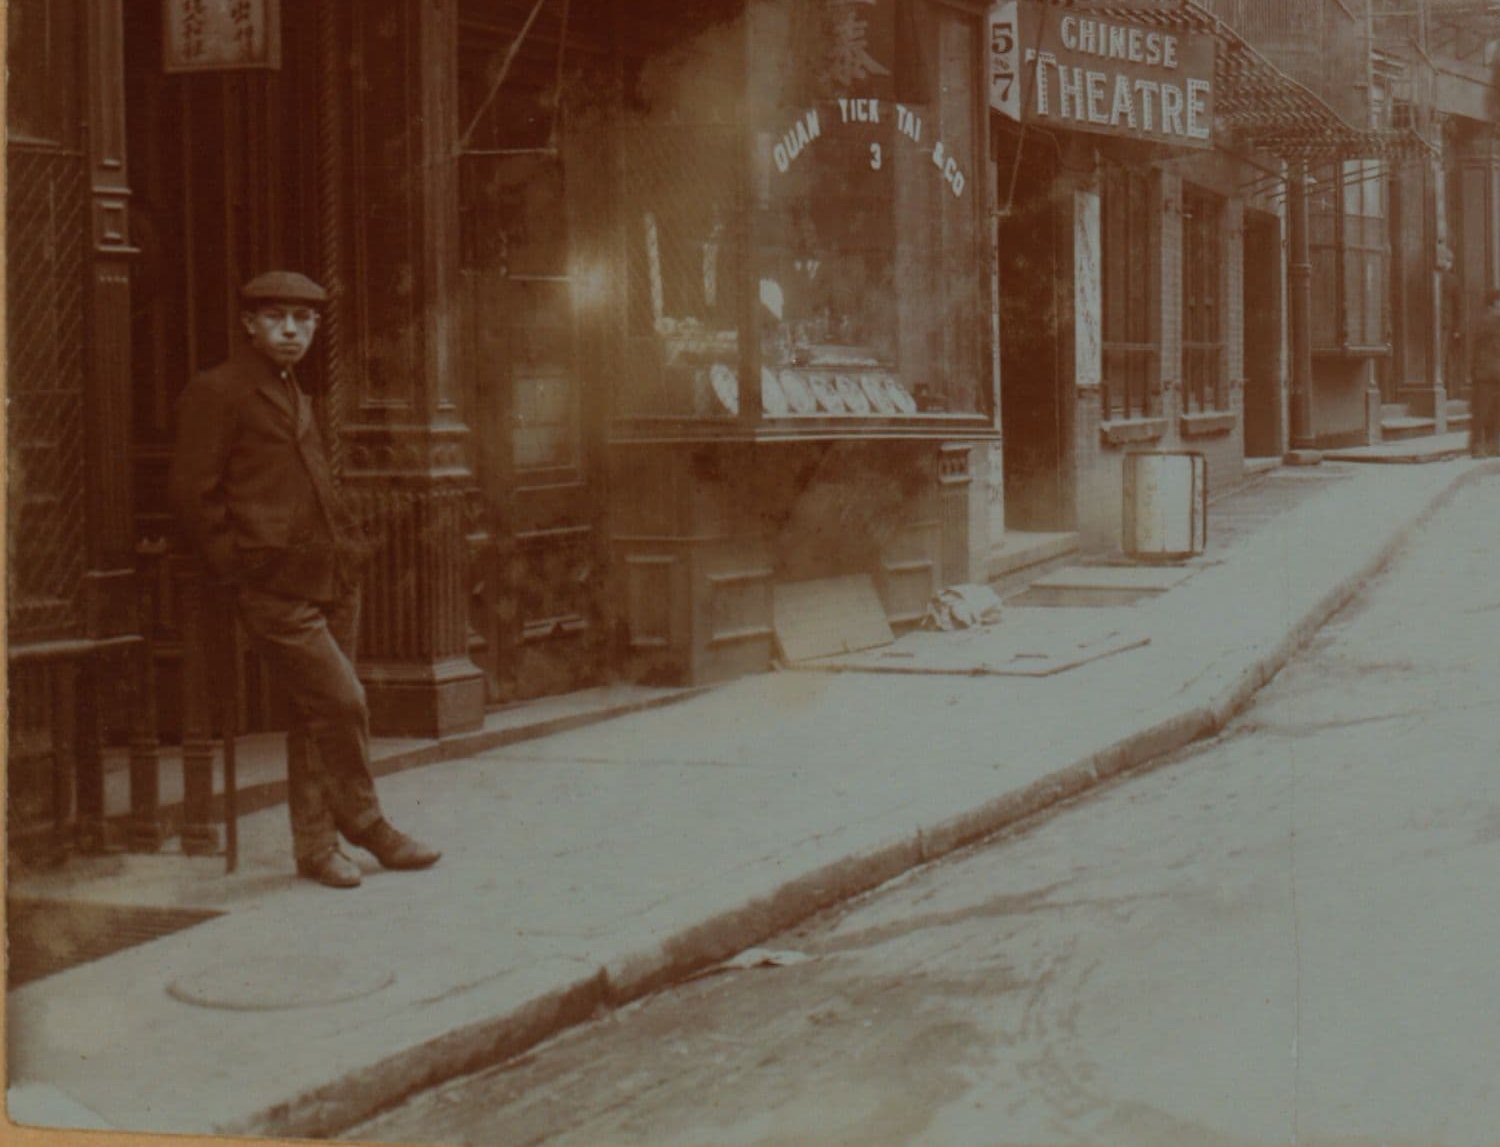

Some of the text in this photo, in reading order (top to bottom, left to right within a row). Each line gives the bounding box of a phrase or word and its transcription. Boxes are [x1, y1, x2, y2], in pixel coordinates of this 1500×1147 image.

[991, 21, 1014, 54] 5
[1061, 15, 1179, 69] CHINESE
[992, 72, 1015, 103] 7
[1024, 47, 1211, 140] THEATRE
[837, 98, 880, 123] YICK
[896, 103, 922, 143] TAI
[869, 142, 882, 170] 3
